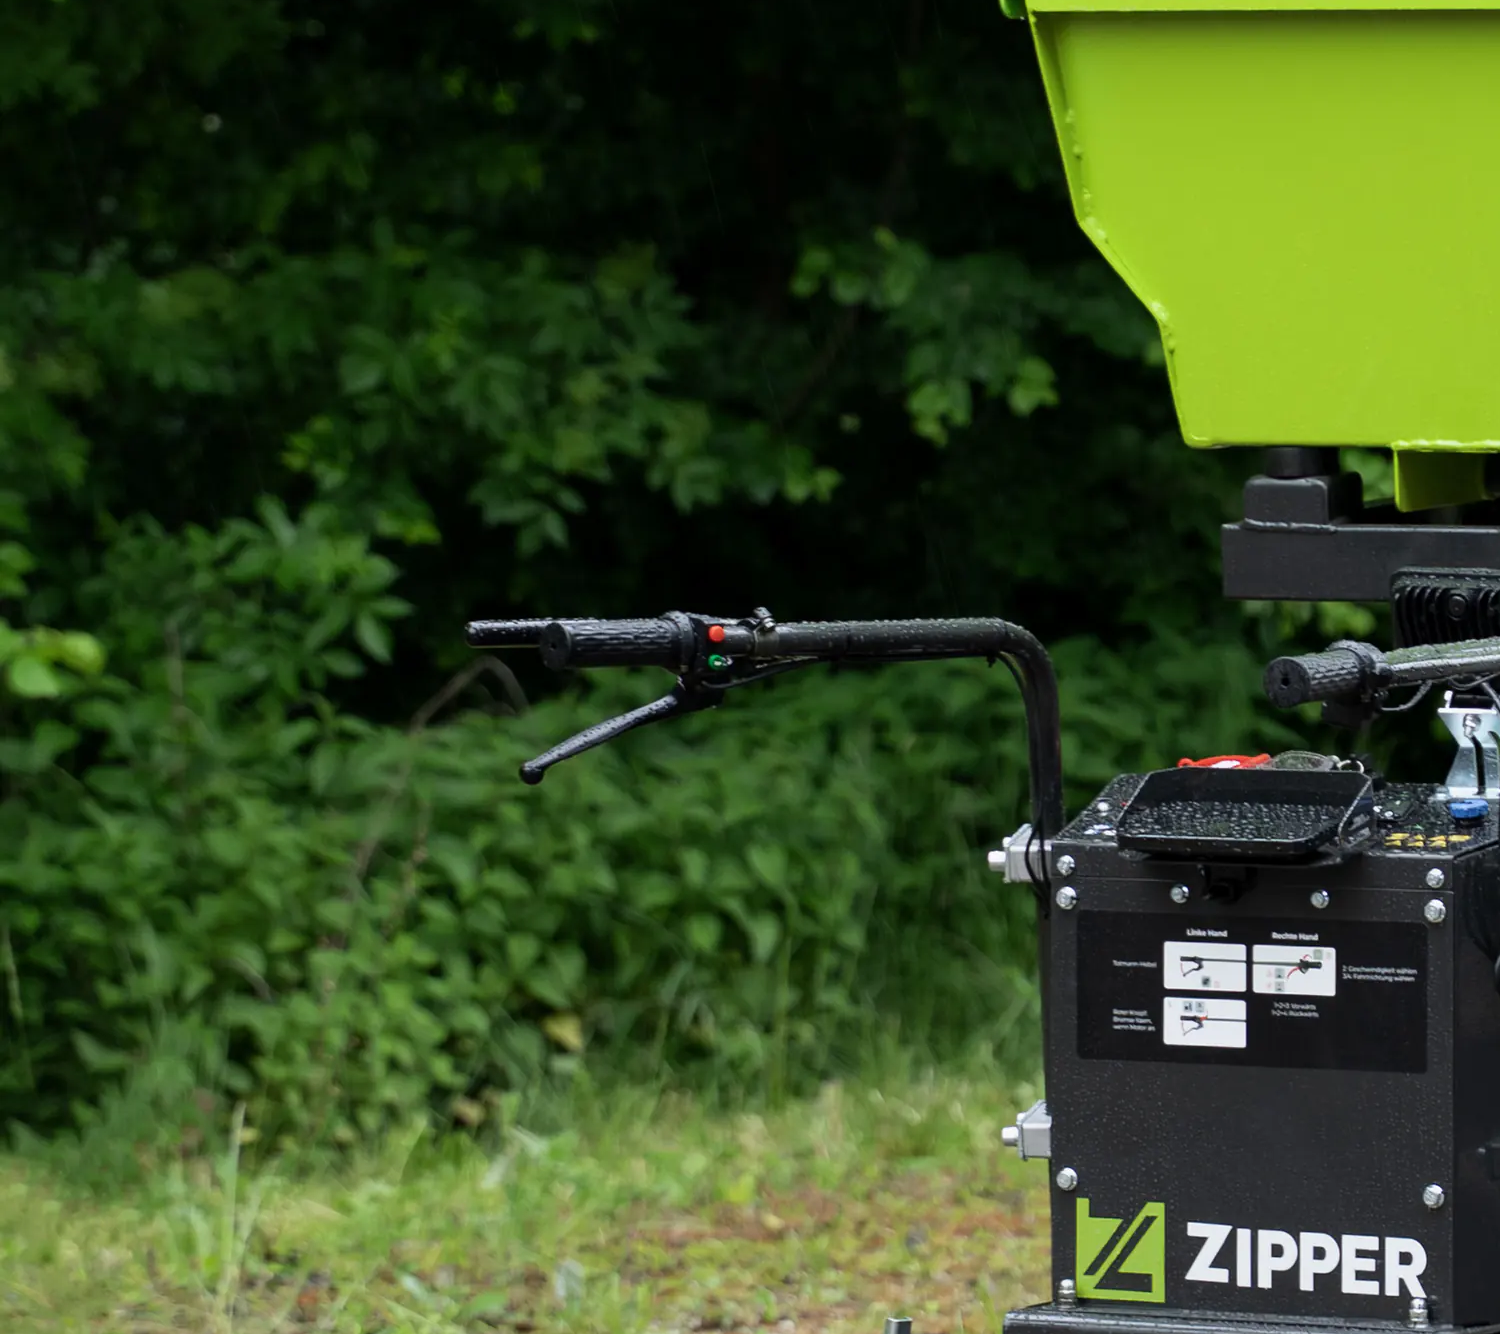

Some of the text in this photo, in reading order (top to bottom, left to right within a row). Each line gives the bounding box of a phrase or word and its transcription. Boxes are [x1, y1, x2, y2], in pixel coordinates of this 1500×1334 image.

[1207, 929, 1228, 938] Hand
[1299, 932, 1319, 941] Hand
[1184, 1221, 1428, 1299] ZIPPER
